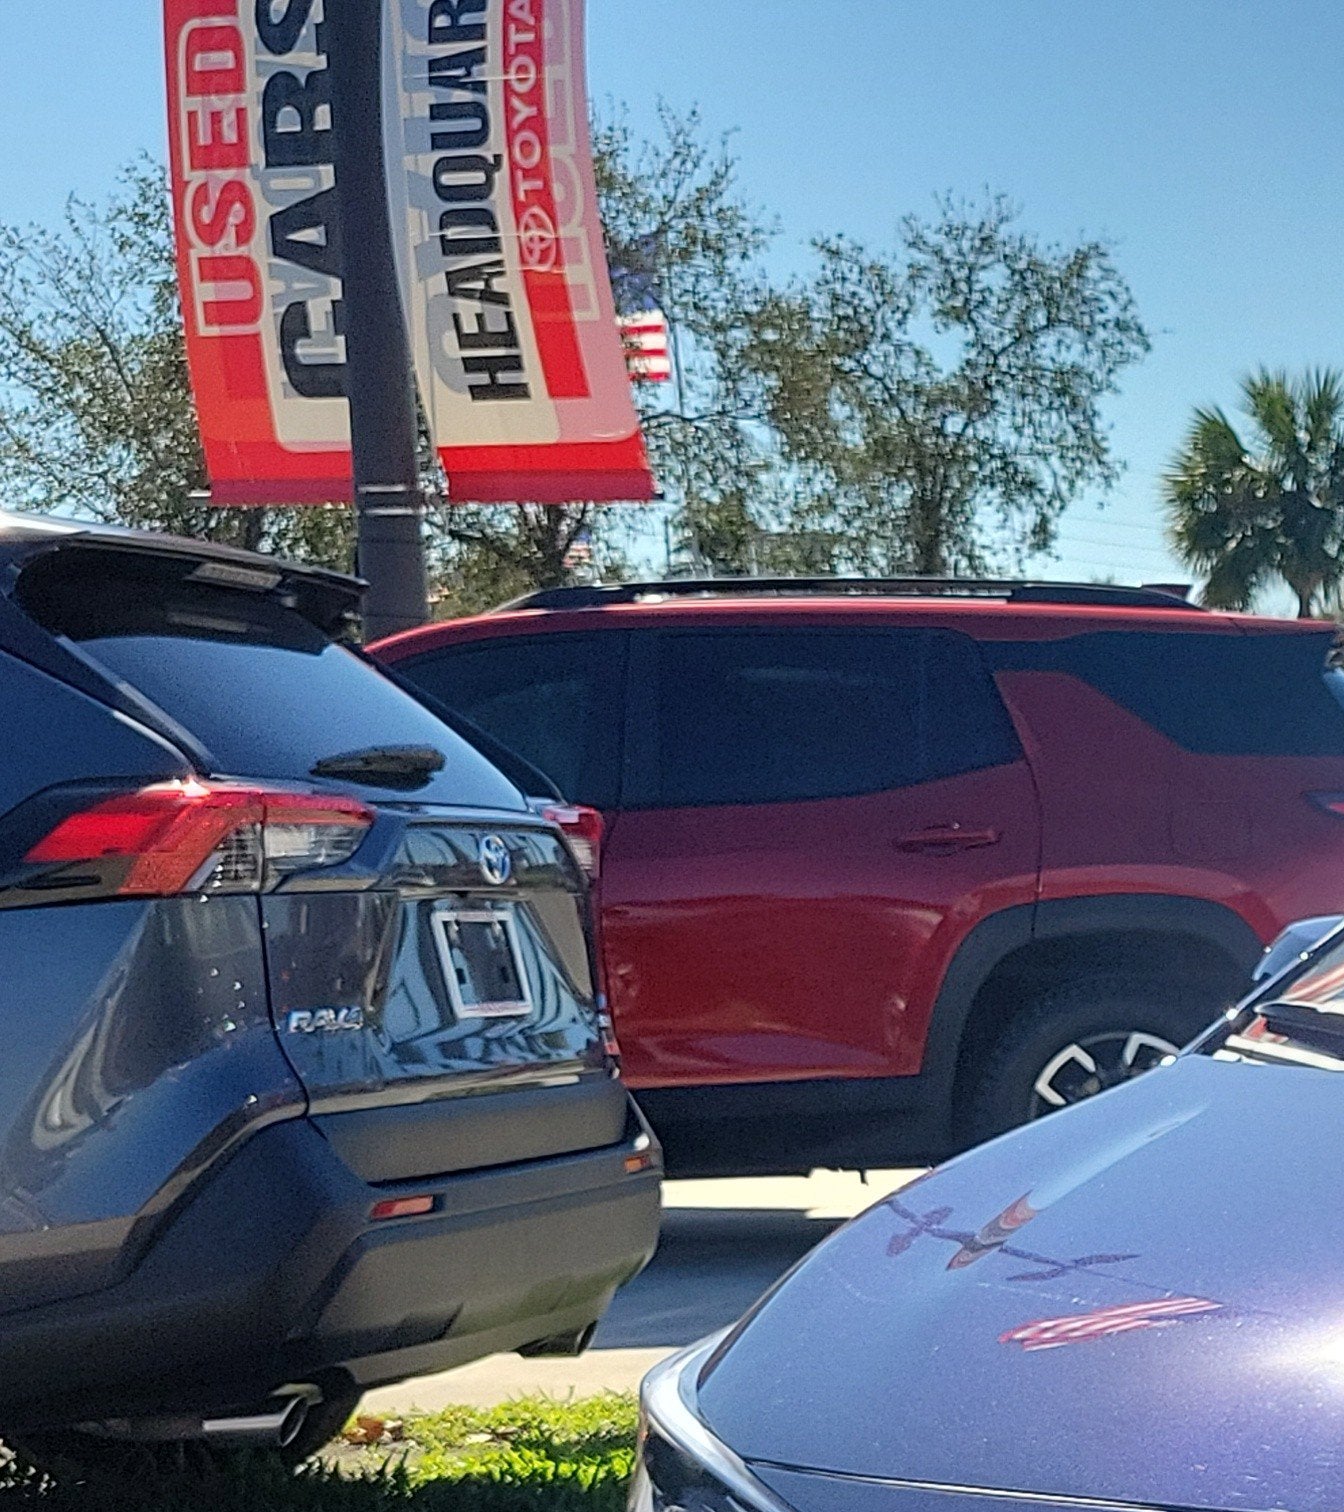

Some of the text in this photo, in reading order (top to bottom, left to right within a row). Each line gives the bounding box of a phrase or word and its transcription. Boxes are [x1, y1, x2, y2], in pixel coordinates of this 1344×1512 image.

[184, 23, 264, 329] USED
[428, 0, 531, 401] HEADQUAR
[508, 0, 544, 203] TOYOTA
